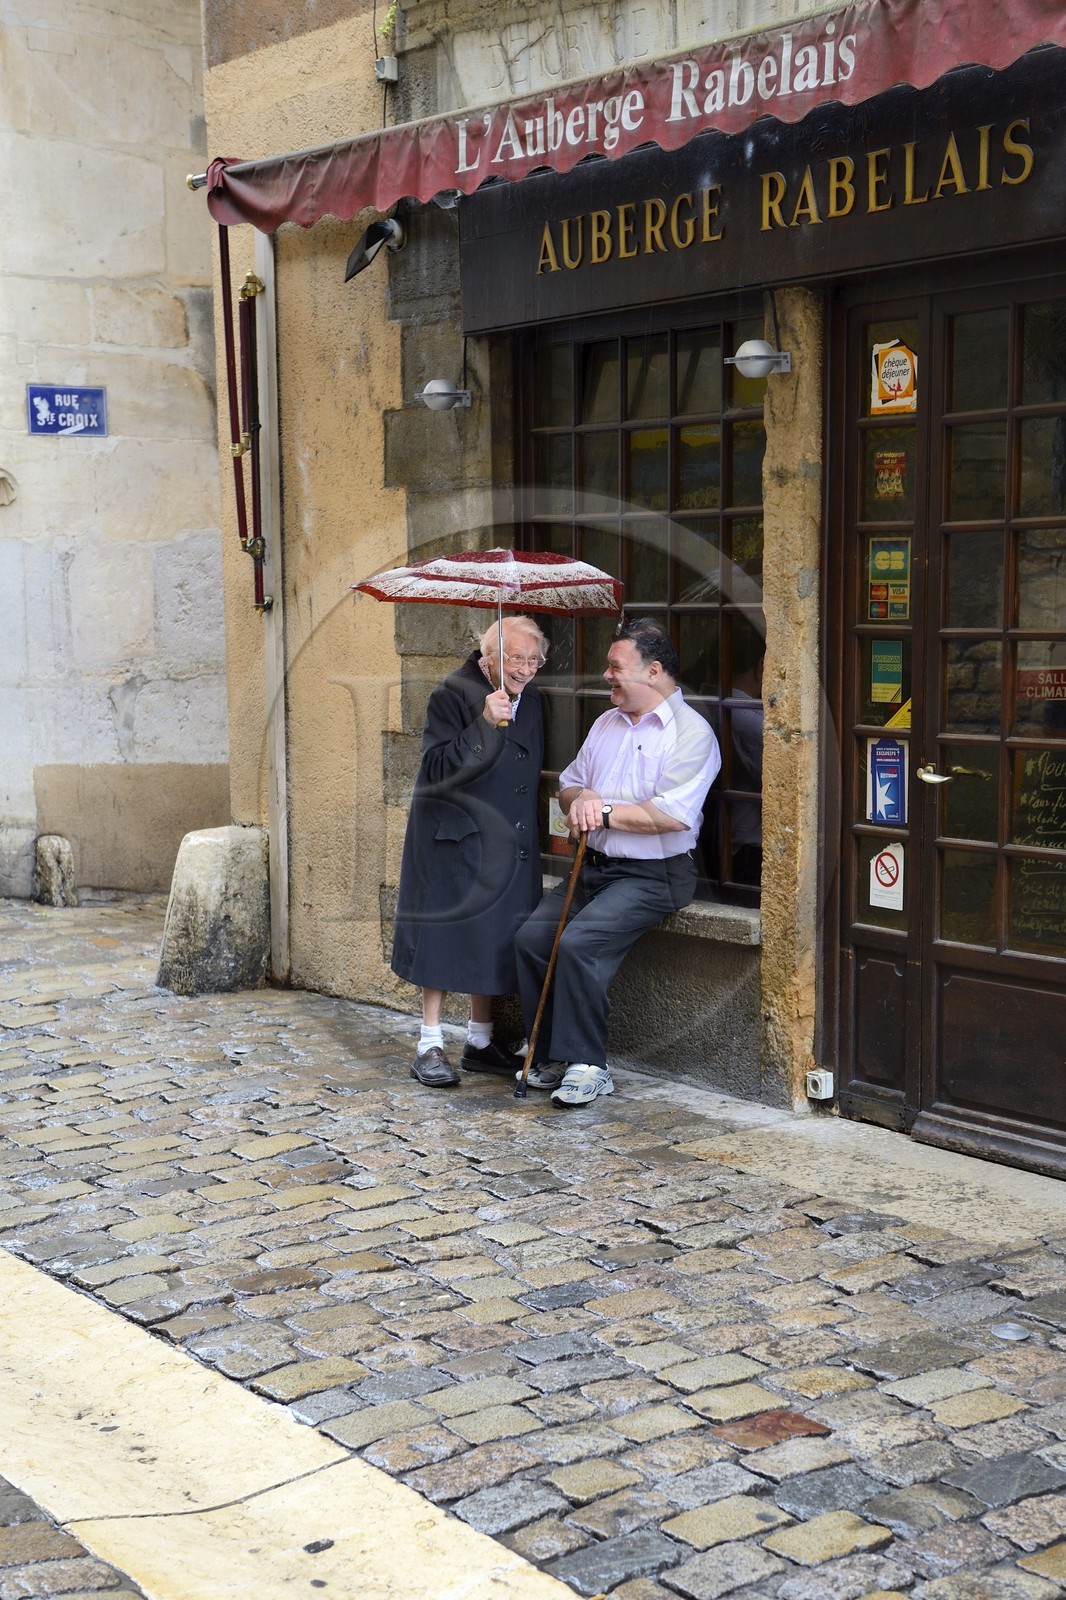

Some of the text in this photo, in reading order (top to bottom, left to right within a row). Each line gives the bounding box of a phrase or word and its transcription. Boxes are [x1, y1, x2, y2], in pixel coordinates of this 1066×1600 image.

[454, 21, 858, 175] L'Auberge Rabelais
[536, 118, 1035, 275] AUBERGE RABELAIS
[884, 357, 908, 369] chèque
[881, 368, 911, 380] déjeuner
[54, 394, 79, 408] RUE
[58, 413, 98, 427] CROIX
[875, 551, 905, 570] CB
